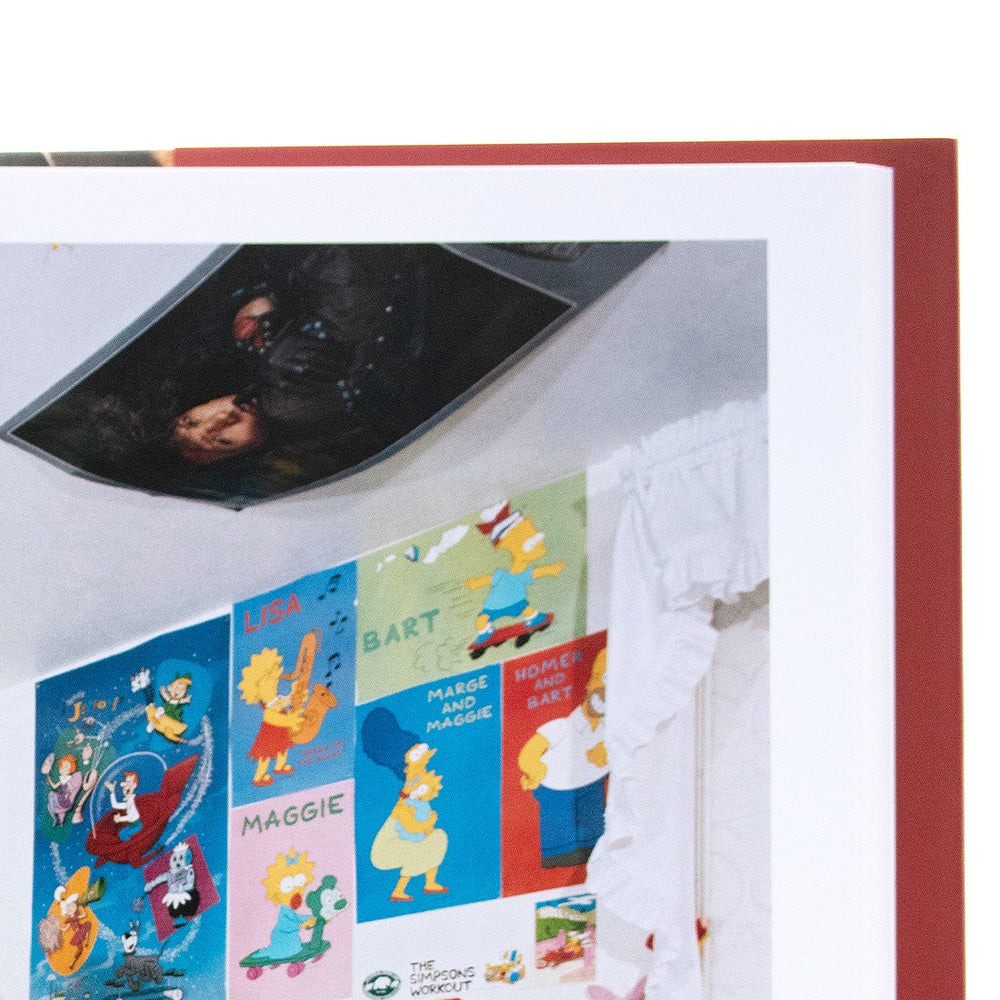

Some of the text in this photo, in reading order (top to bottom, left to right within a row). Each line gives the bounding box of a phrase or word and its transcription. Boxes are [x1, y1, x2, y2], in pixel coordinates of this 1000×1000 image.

[244, 593, 302, 634] LISA
[362, 609, 440, 653] BART
[515, 650, 584, 681] HOMER
[427, 675, 488, 702] MARGE
[534, 673, 566, 691] AND
[441, 695, 476, 714] AND
[527, 686, 573, 709] BART
[426, 705, 492, 732] MAGGIE
[242, 794, 345, 836] MAGGIE
[410, 960, 436, 972] THE
[410, 967, 475, 984] SIMPSONS
[410, 981, 472, 996] WORKOUT
